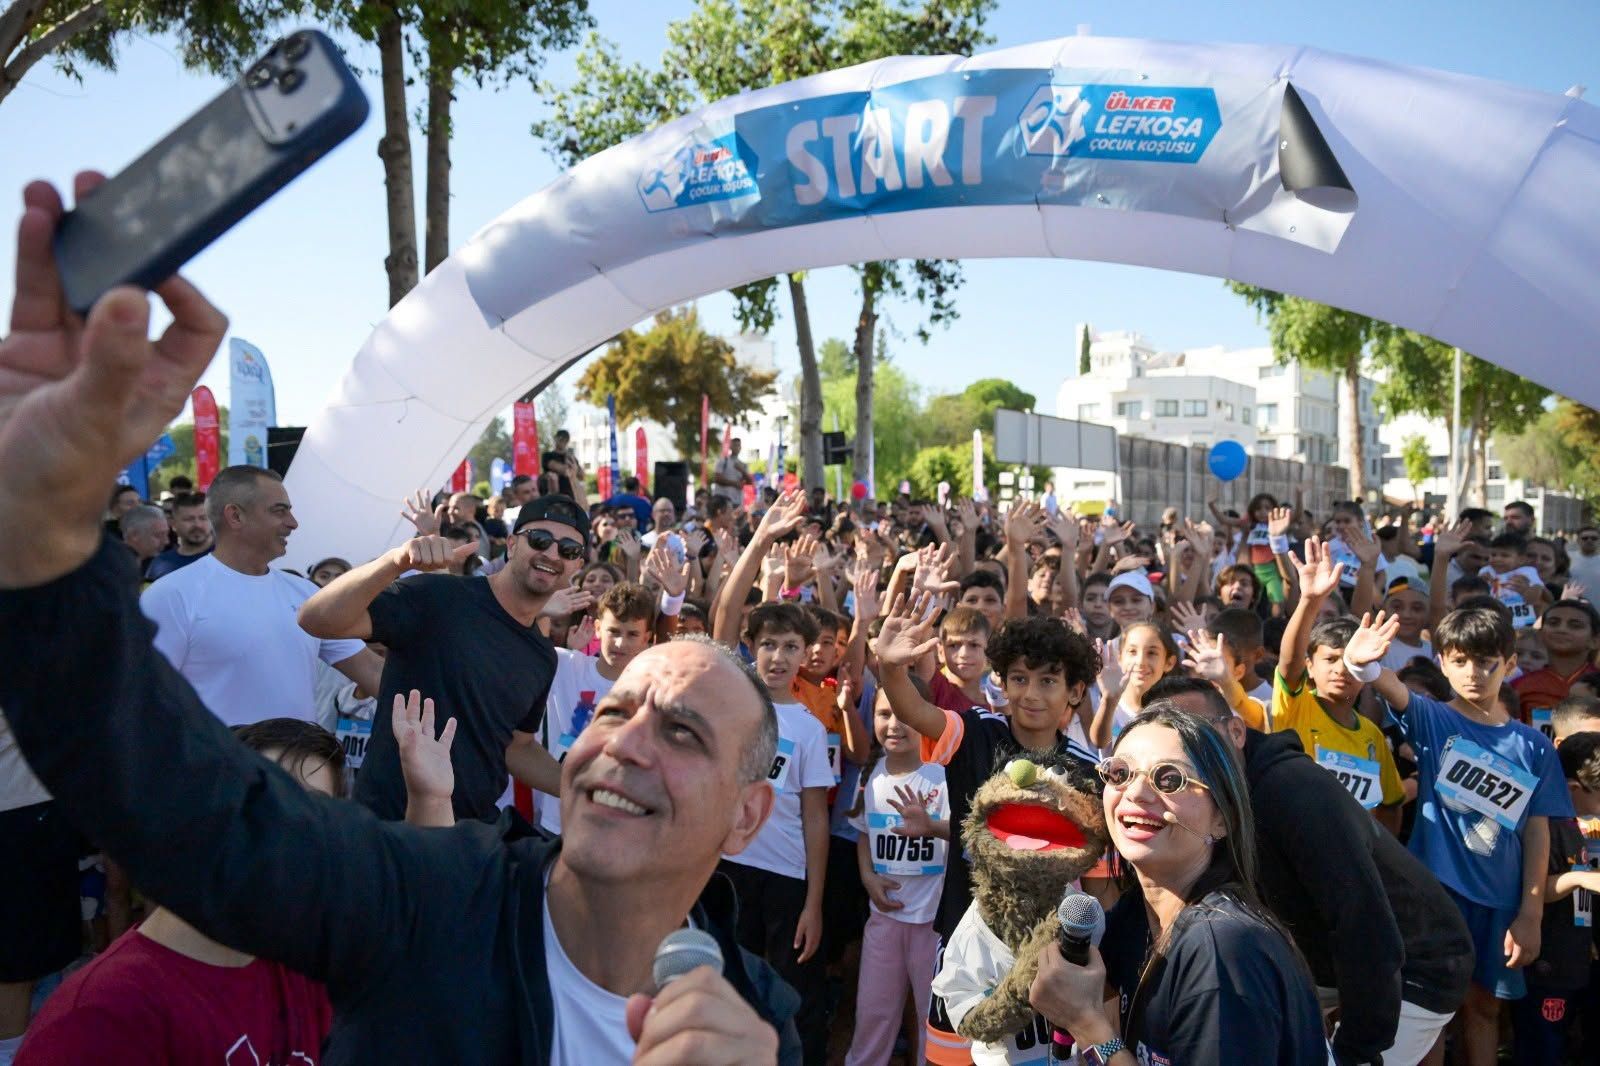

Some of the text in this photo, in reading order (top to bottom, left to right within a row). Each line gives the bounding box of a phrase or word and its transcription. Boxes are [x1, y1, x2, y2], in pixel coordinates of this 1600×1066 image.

[1105, 90, 1176, 113] ÜLKER
[1095, 114, 1205, 140] LEFKOŞA
[785, 95, 998, 206] START
[1090, 138, 1197, 156] ÇOCUK KOŞUSU
[1446, 759, 1524, 810] 00527
[876, 834, 935, 862] 00755
